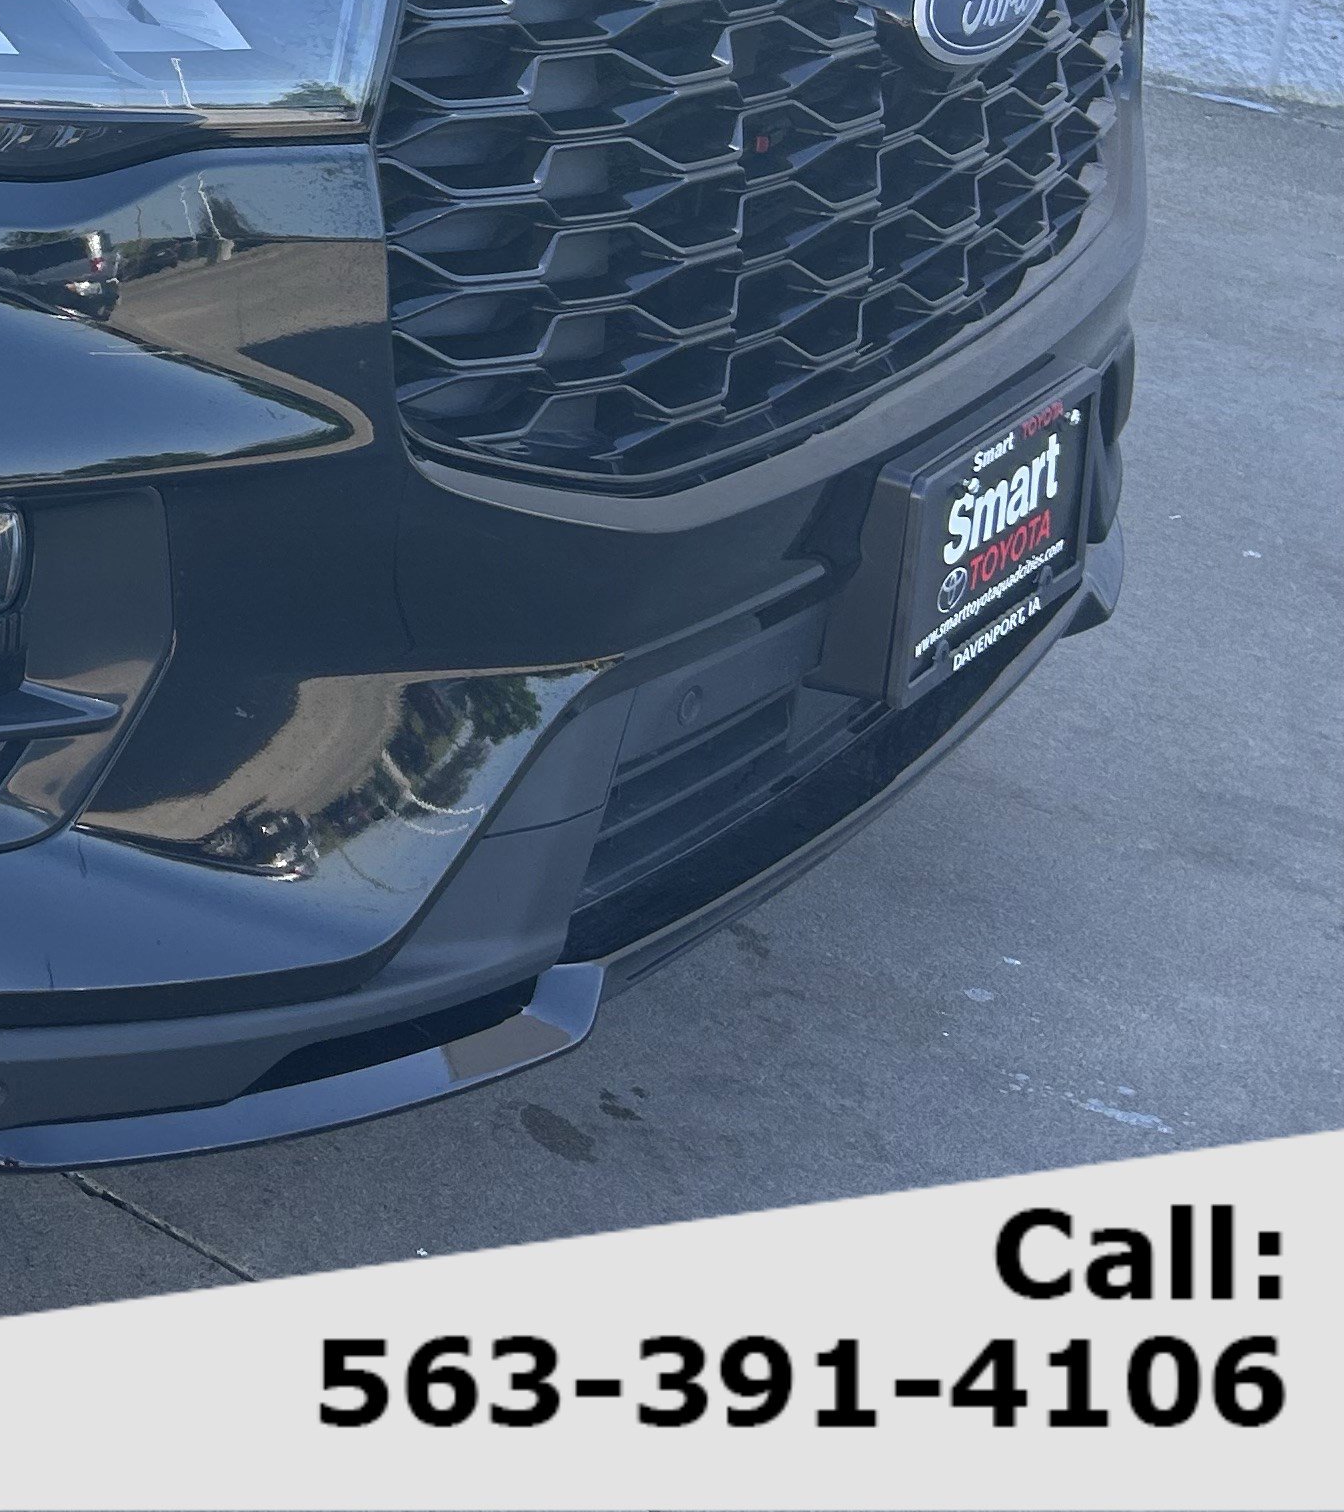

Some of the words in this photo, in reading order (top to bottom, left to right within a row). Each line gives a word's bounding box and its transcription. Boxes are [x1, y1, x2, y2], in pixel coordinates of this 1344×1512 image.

[973, 431, 1014, 472] Smart
[943, 432, 1061, 566] Smart
[969, 509, 1052, 590] TOYOTA
